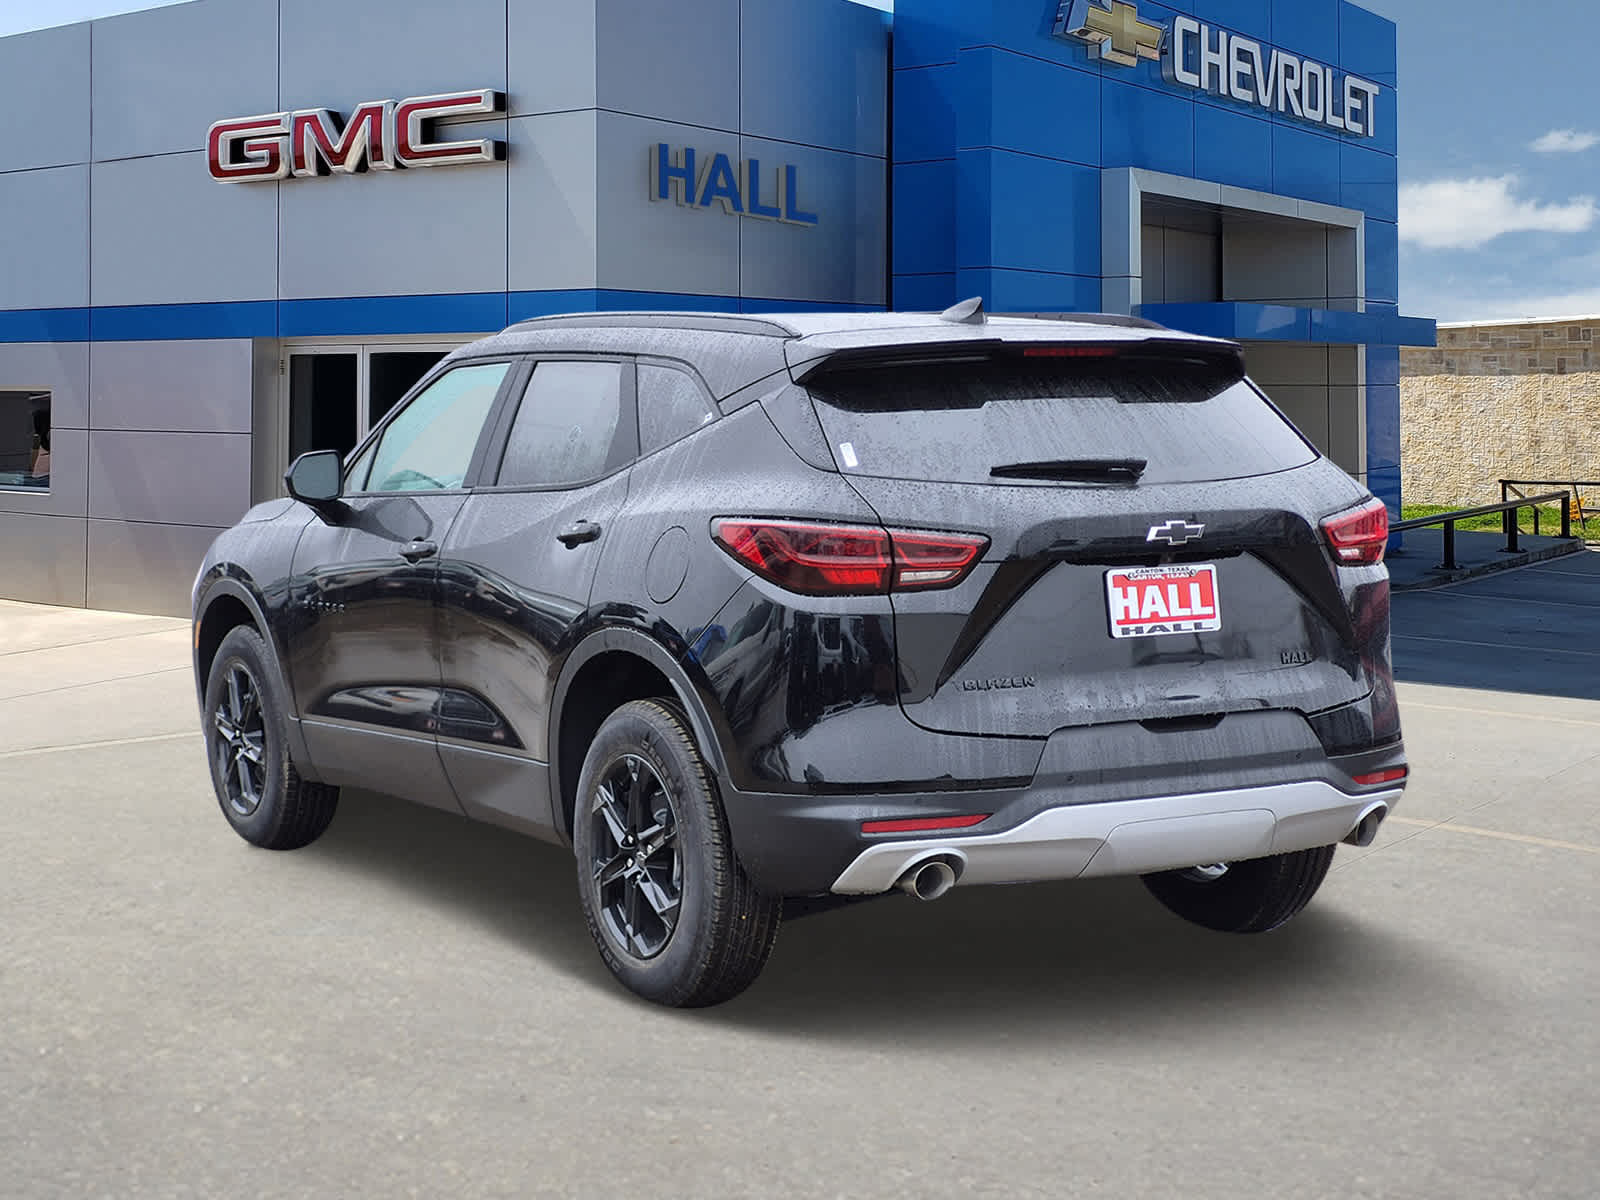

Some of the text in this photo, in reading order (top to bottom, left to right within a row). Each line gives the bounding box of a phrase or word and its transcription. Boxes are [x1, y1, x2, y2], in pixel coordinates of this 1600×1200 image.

[1172, 15, 1379, 137] CHEVROLET
[206, 88, 506, 184] GMC
[651, 142, 818, 228] HALL
[1112, 582, 1214, 620] HALL
[1121, 621, 1213, 636] HALL
[962, 676, 1036, 692] BLAZER
